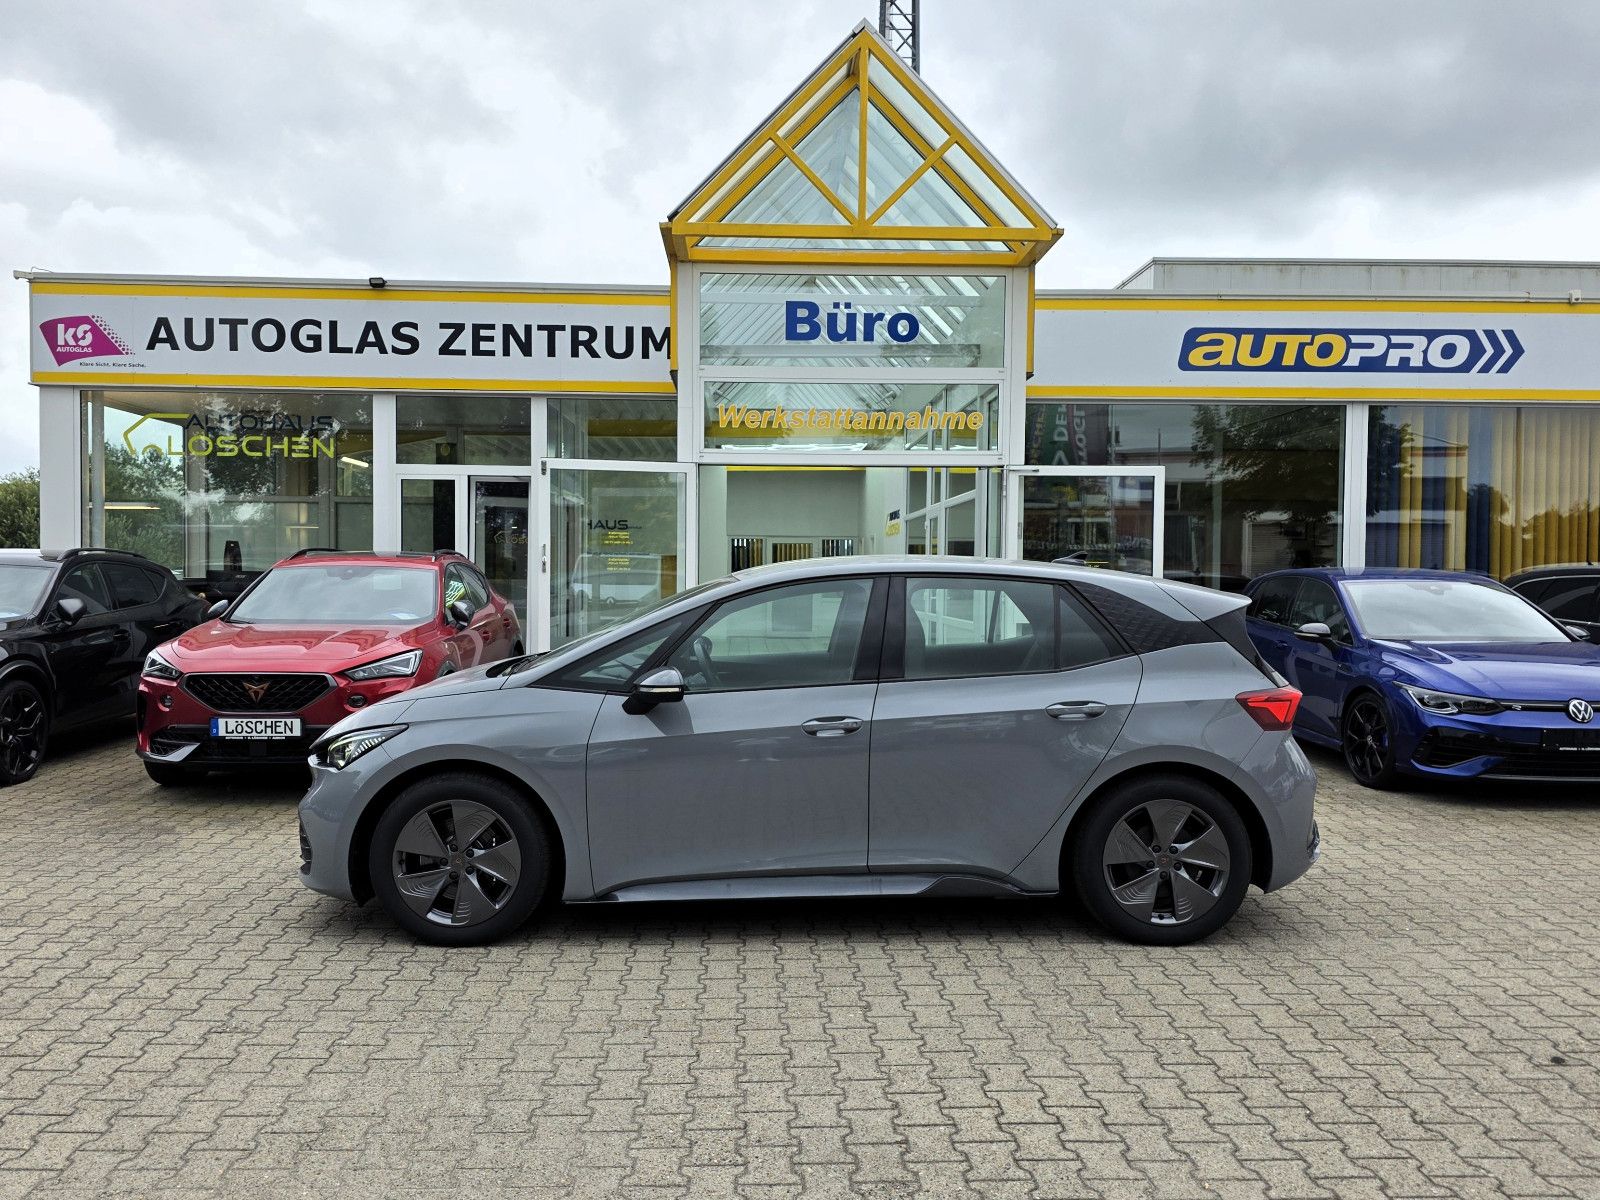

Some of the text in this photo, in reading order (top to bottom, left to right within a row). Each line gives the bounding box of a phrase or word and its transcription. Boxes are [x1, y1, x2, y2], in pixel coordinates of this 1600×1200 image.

[785, 300, 920, 342] Büro
[146, 317, 671, 360] AUTOGLAS ZENTRUM
[186, 414, 333, 430] AUTOHAUS
[718, 404, 984, 430] Werkstattannahme
